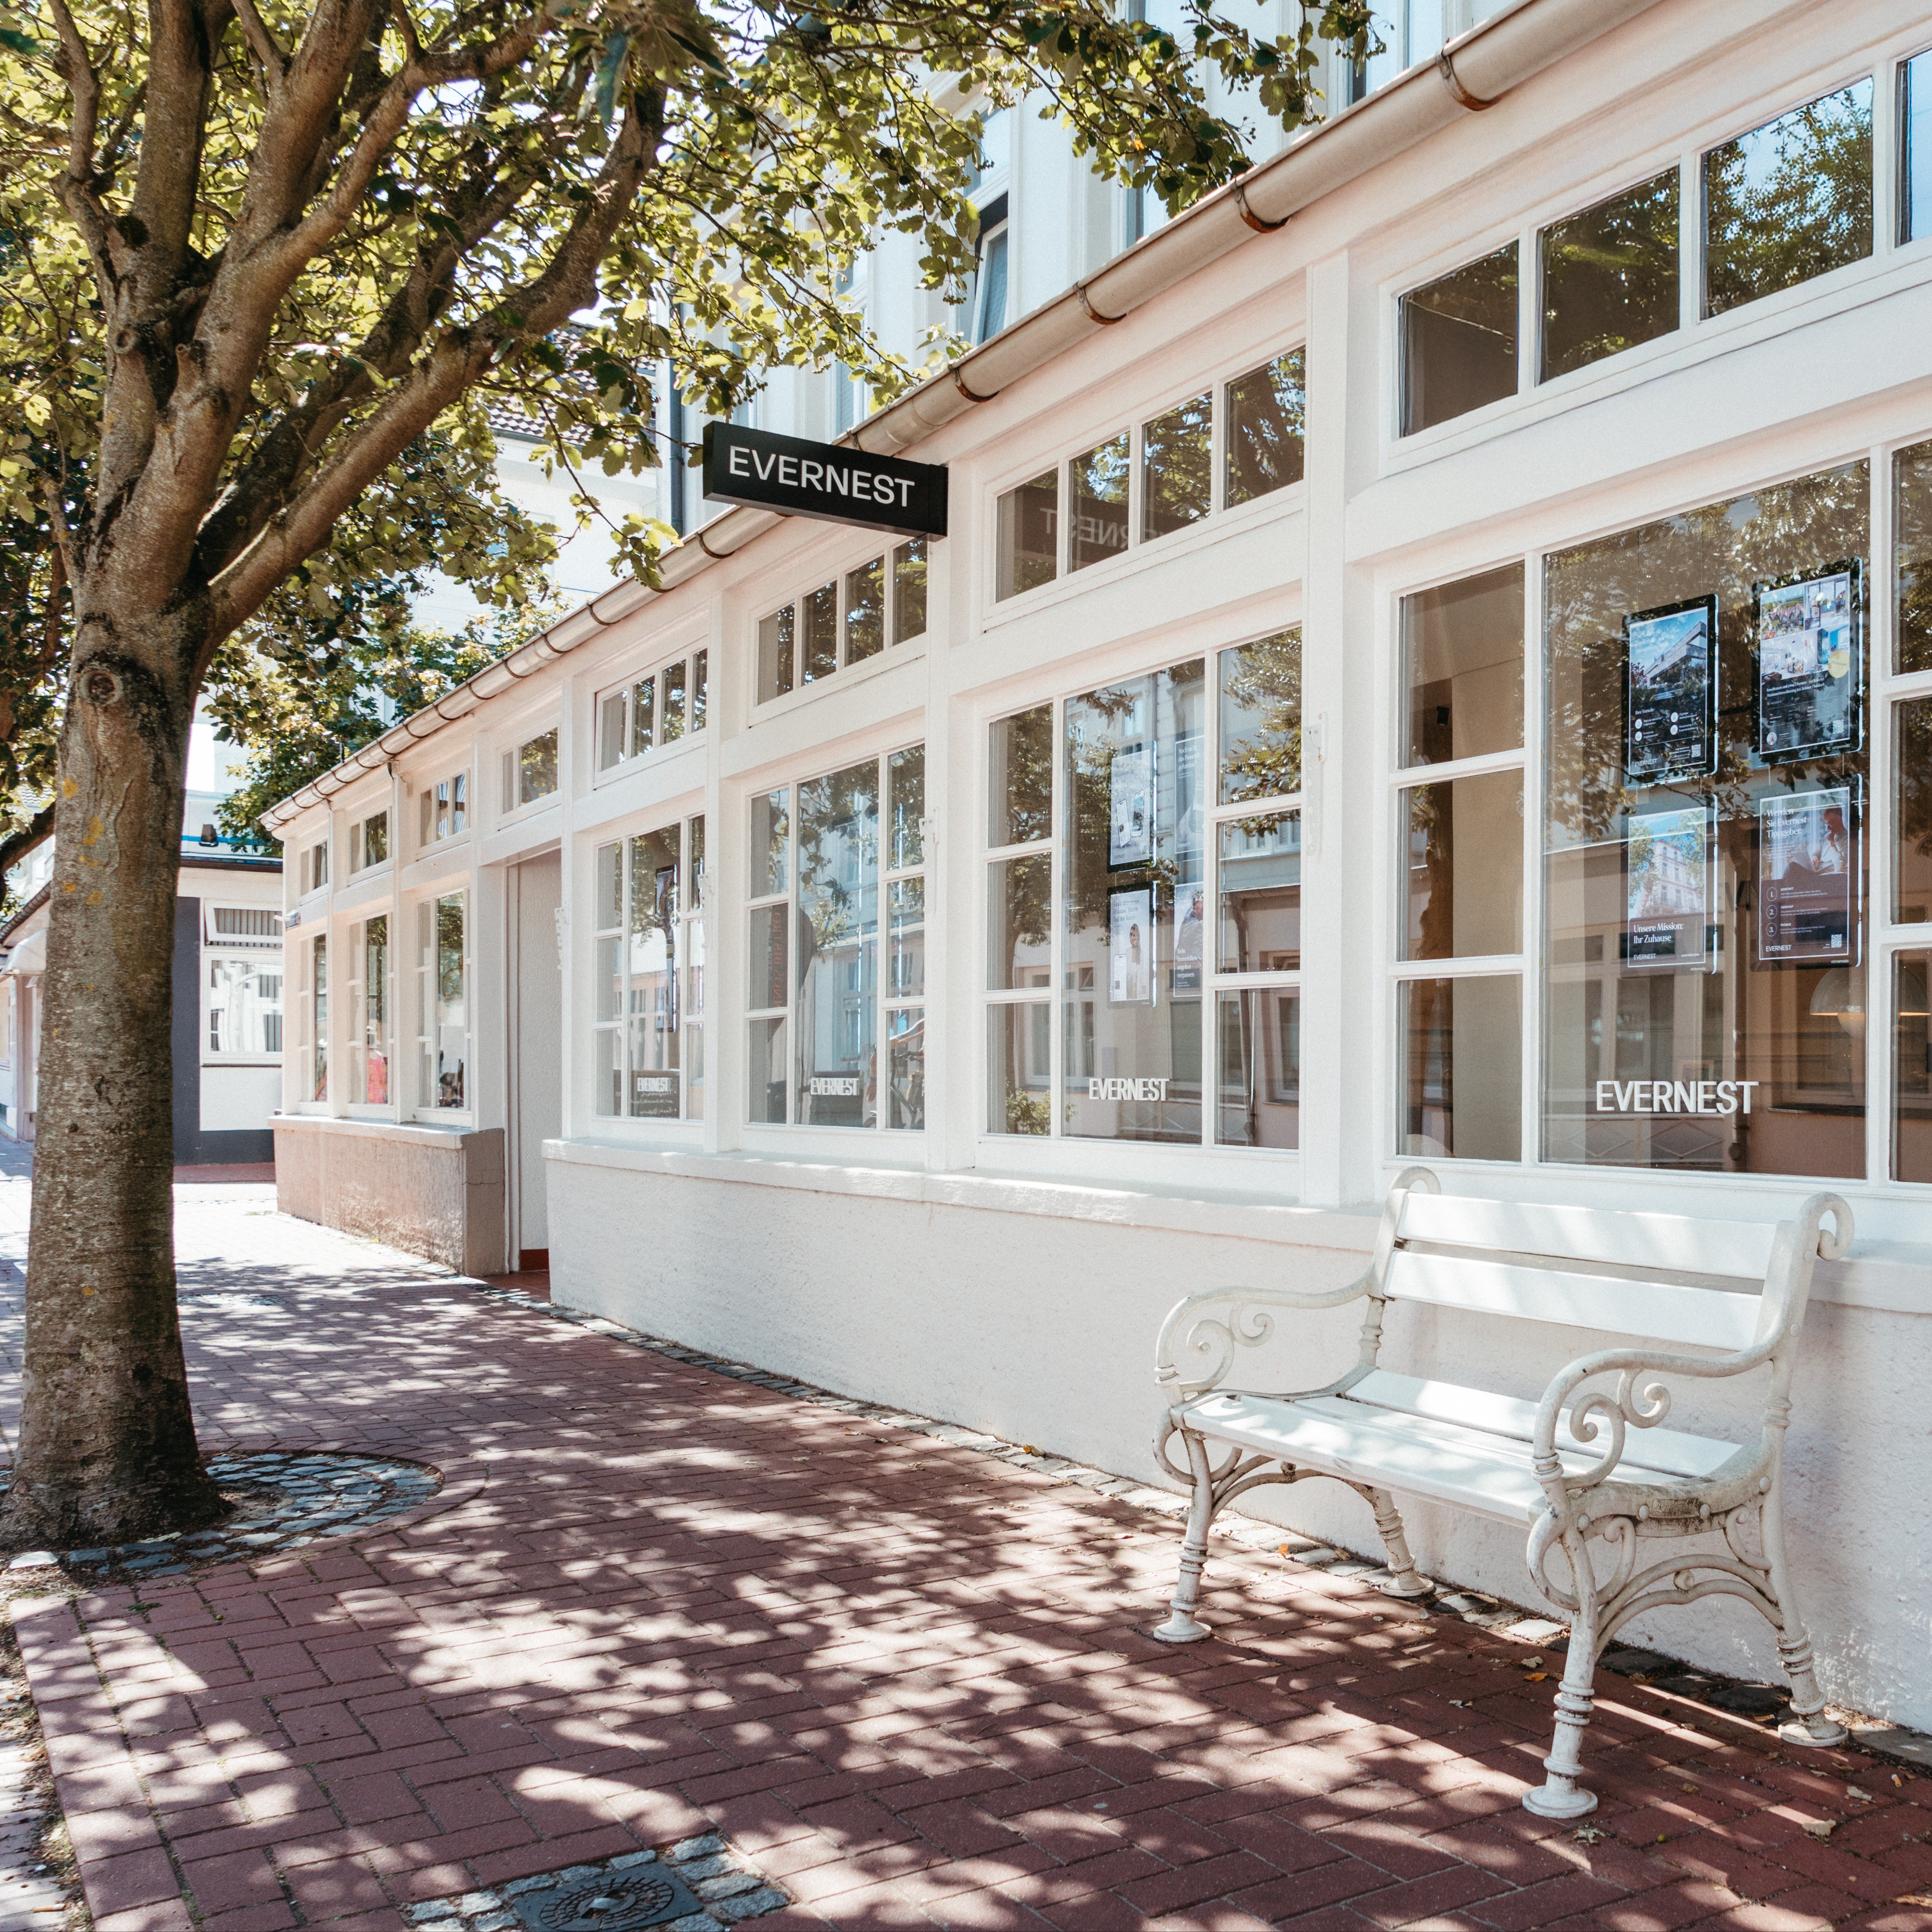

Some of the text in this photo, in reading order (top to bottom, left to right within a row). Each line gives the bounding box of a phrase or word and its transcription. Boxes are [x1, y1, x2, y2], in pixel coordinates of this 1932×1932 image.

[729, 445, 915, 507] EVERNEST
[1634, 758, 1658, 767] EVERNEST
[1767, 807, 1794, 817] Werden
[1778, 816, 1810, 826] Evernest-
[1766, 827, 1802, 840] Tippgeber.
[1633, 922, 1683, 933] Unsere Mission:
[1633, 934, 1672, 944] Ihr Zuhause
[1177, 963, 1191, 972] angebot
[810, 1078, 859, 1096] EVERNEST
[1089, 1078, 1170, 1101] EVERNEST
[1596, 1081, 1759, 1114] EVERNEST
